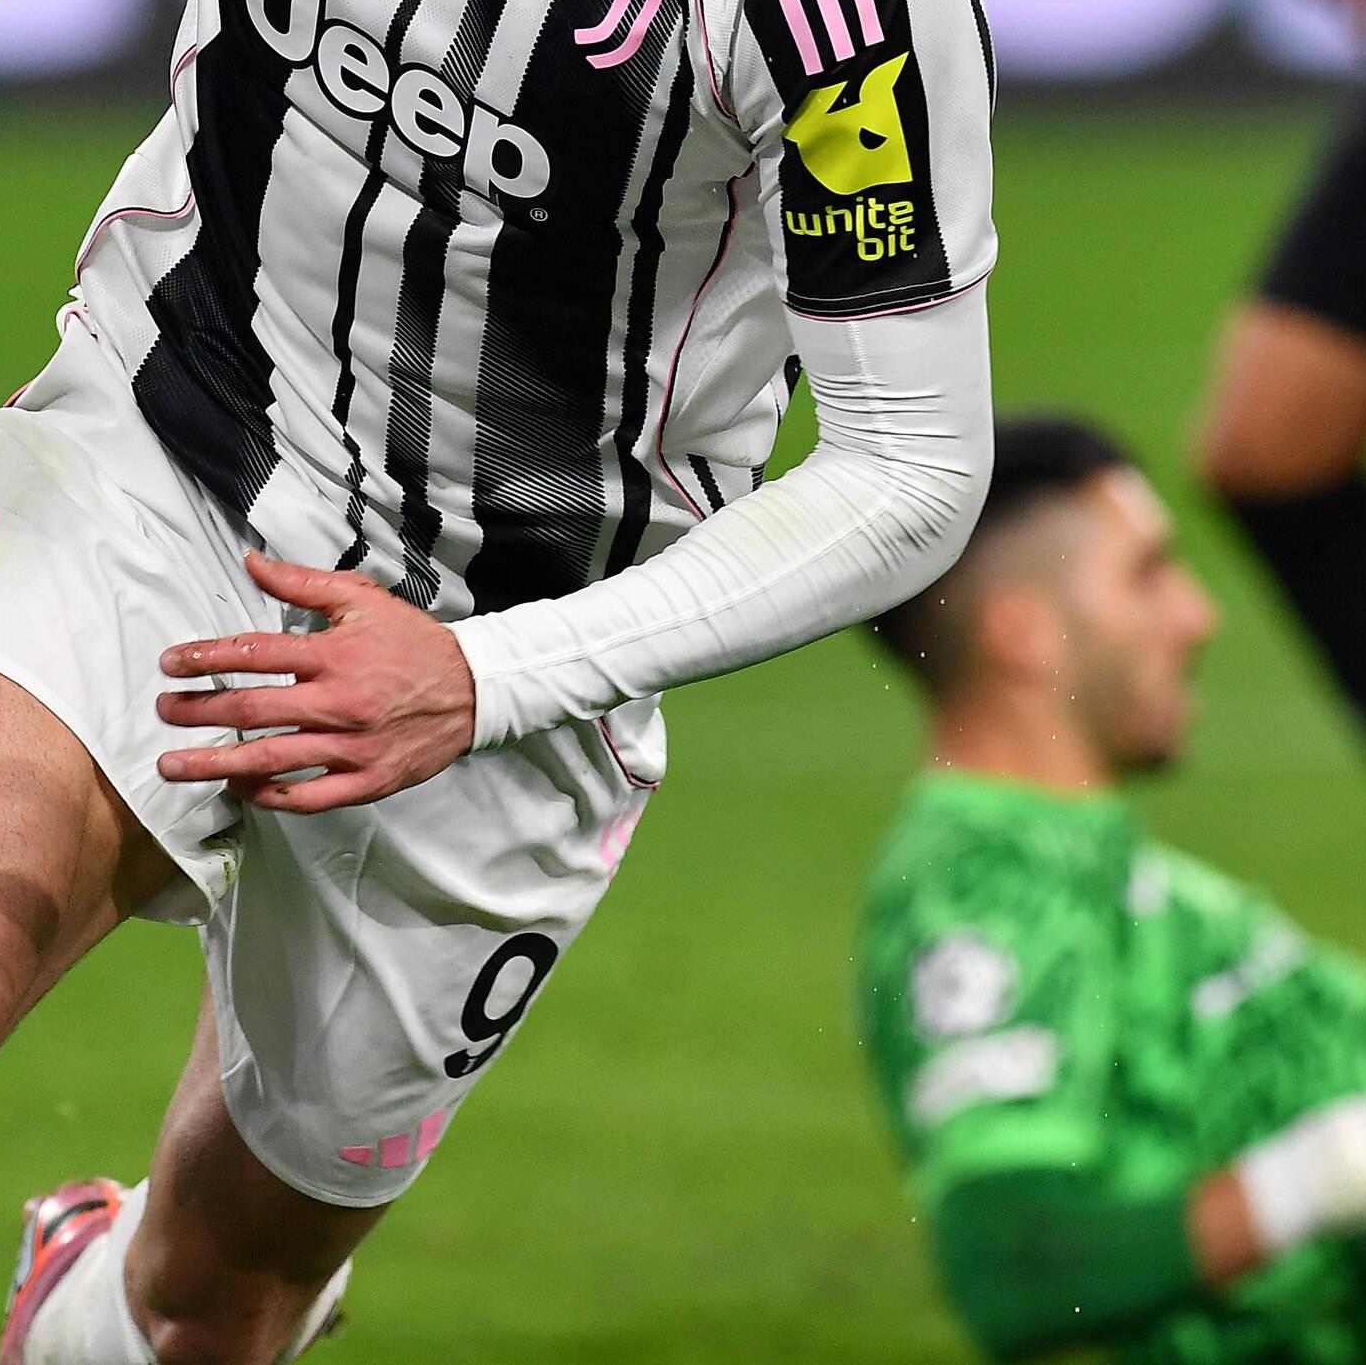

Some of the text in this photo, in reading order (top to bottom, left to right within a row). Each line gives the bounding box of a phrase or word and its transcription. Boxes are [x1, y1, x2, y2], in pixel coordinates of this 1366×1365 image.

[785, 195, 915, 238] white
[856, 225, 916, 262] bit
[443, 931, 560, 1080] 9
